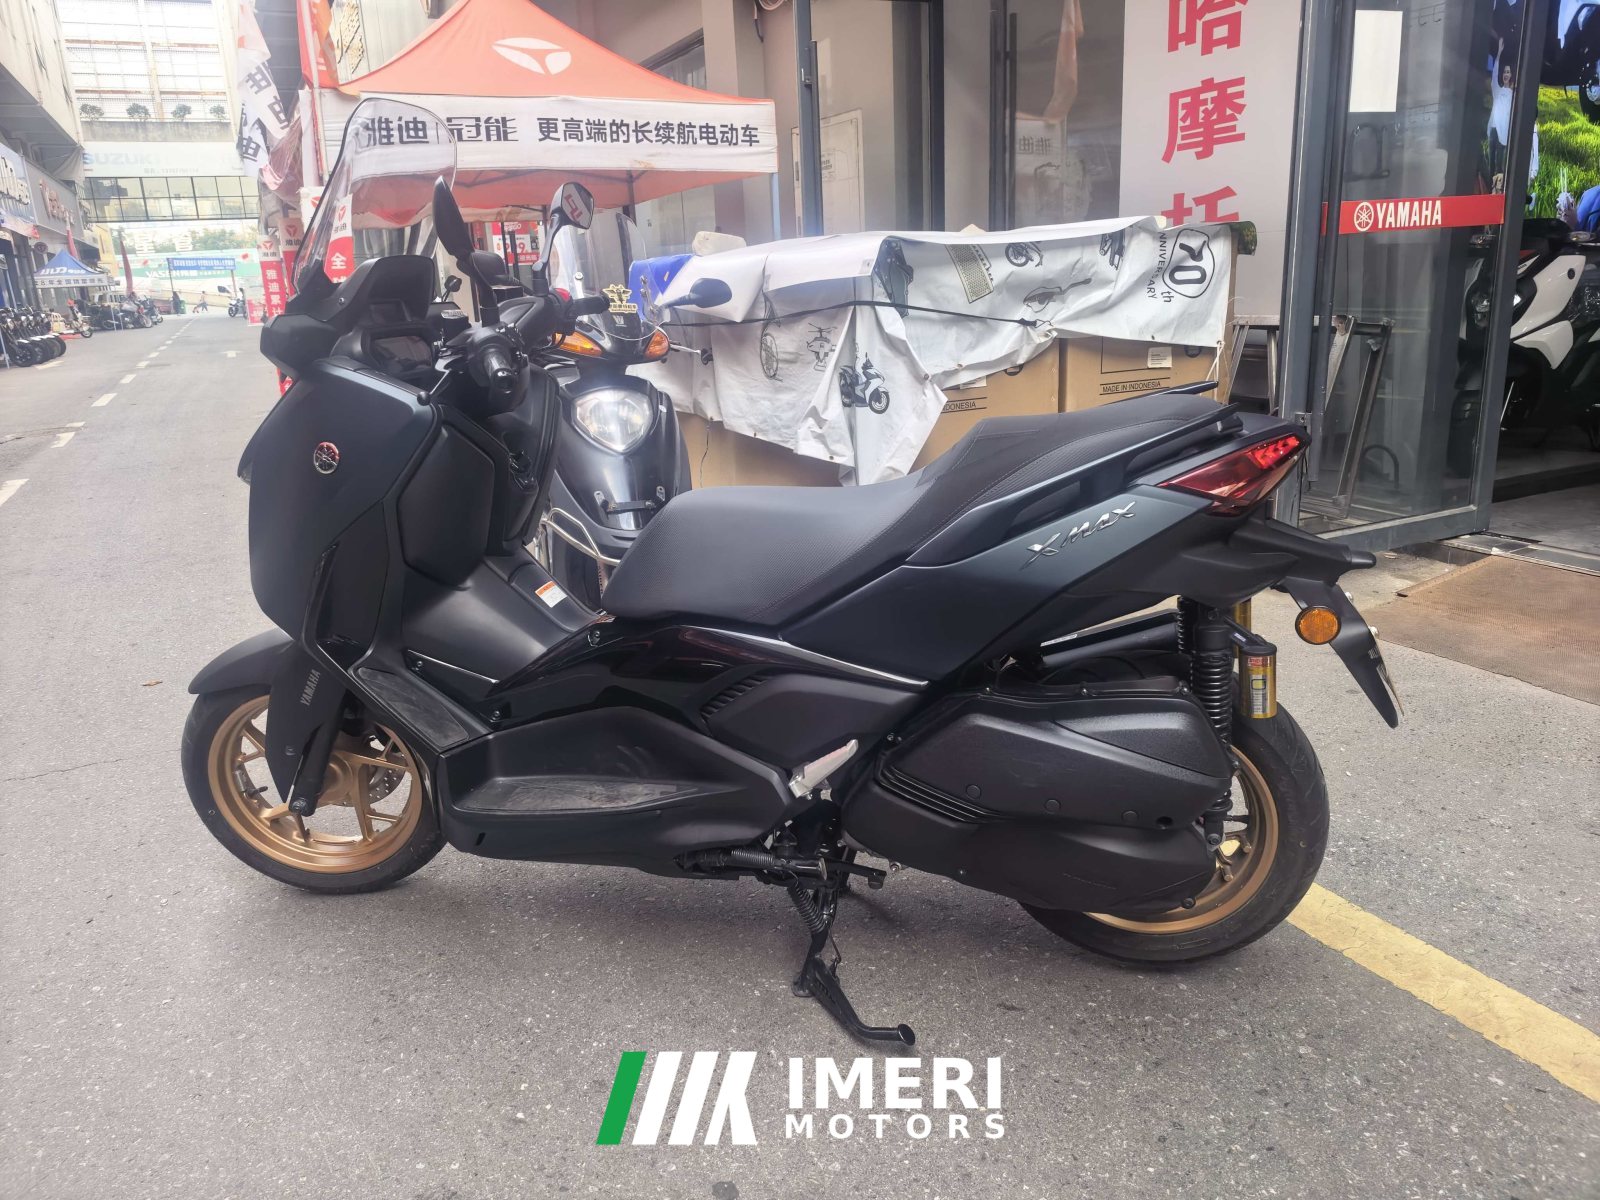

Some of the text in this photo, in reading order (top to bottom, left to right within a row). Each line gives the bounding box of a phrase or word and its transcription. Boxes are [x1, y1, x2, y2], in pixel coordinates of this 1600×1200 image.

[446, 116, 519, 142] 冠能
[537, 116, 760, 147] 更高端的长续航电动车
[1376, 200, 1442, 229] YAMAHA
[1102, 385, 1120, 393] MADE
[1129, 380, 1161, 390] INDONESIA
[300, 669, 321, 706] YAMAHA
